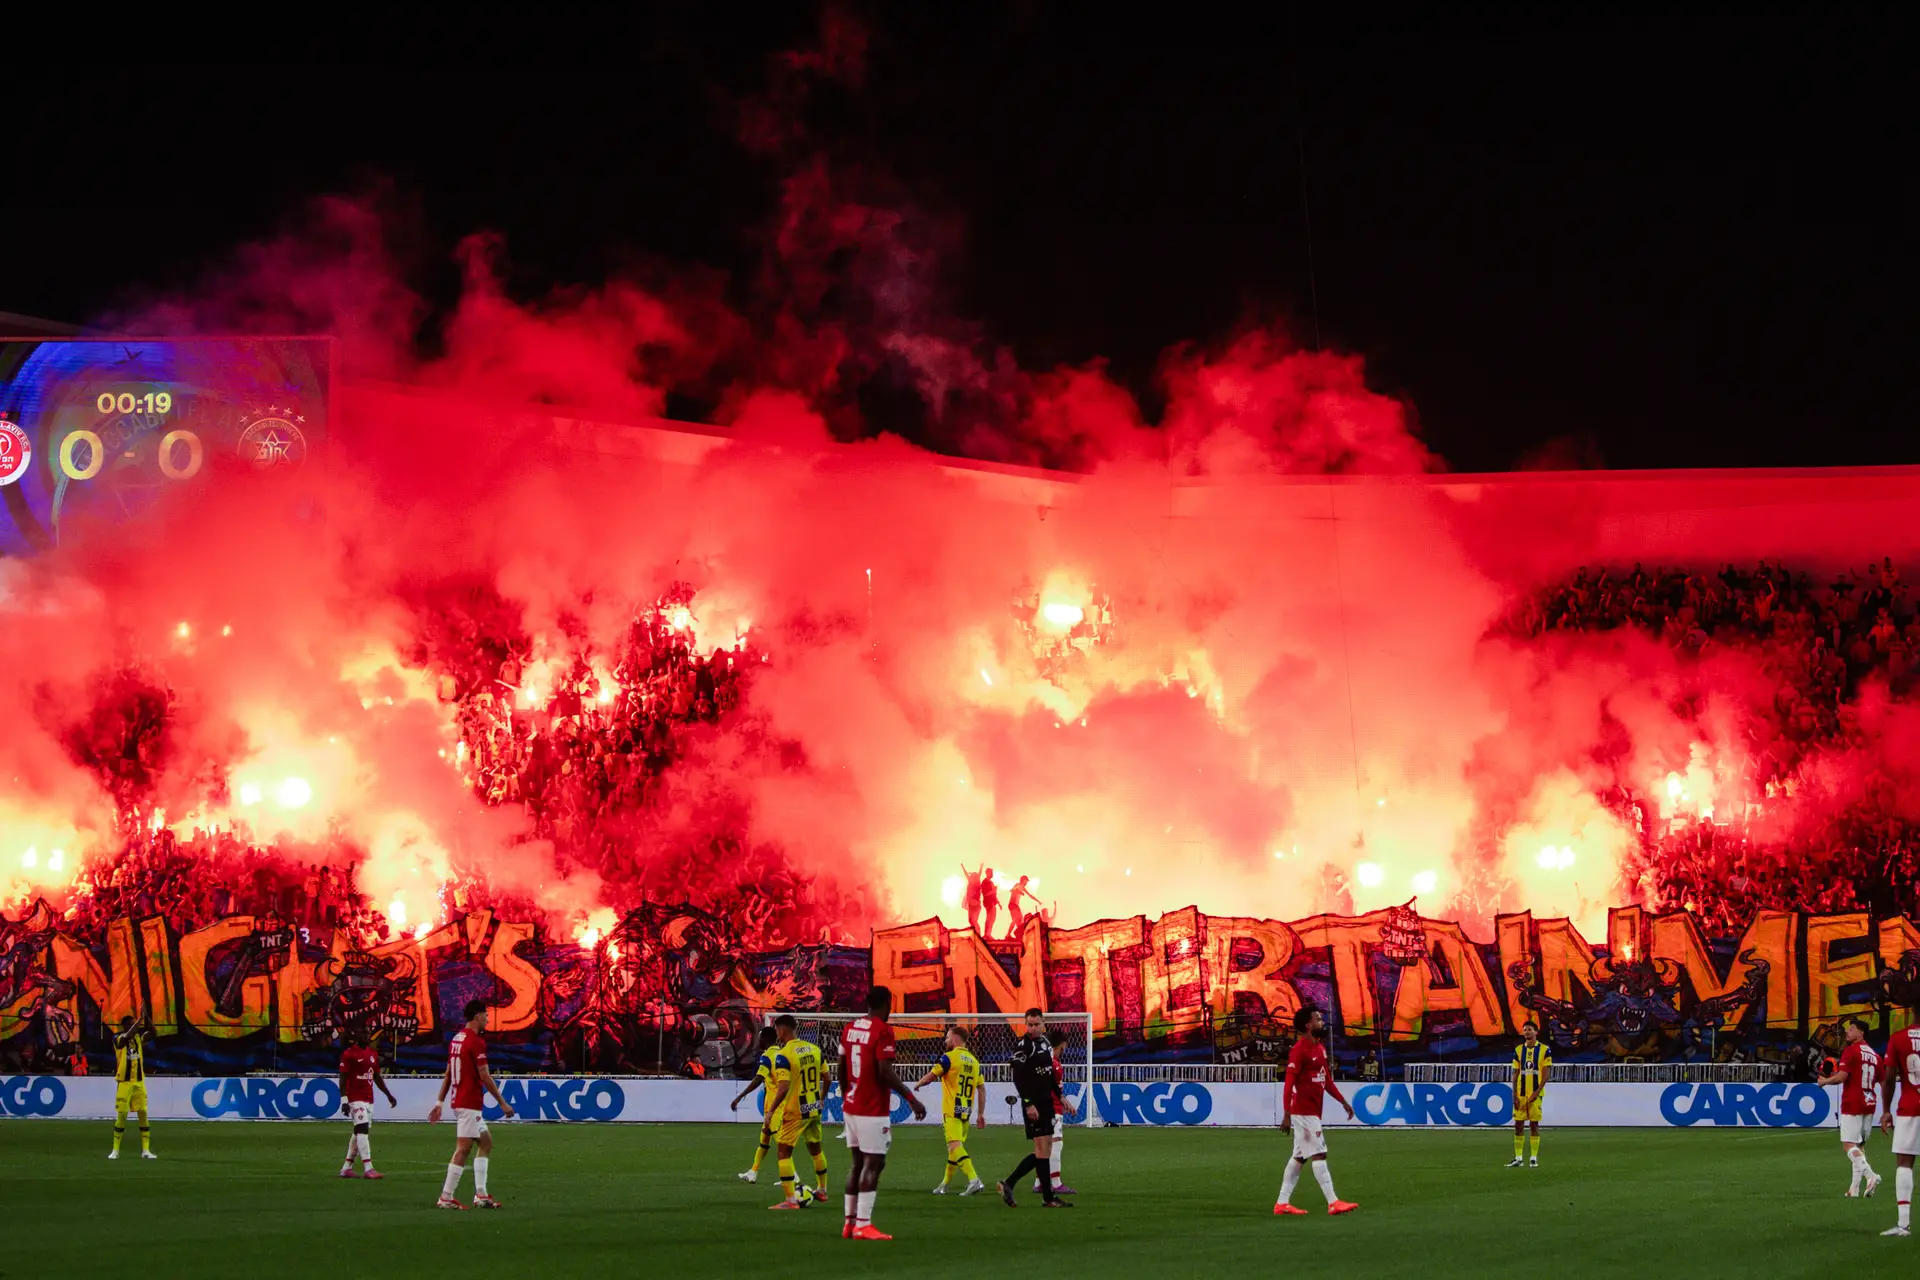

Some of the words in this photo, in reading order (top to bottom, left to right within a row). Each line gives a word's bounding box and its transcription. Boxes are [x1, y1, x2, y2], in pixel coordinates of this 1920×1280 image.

[97, 393, 172, 413] 00:19
[59, 430, 104, 480] 0
[158, 430, 203, 480] 0
[260, 934, 282, 948] TNT
[1391, 930, 1414, 946] TNT
[1222, 1046, 1249, 1064] TNT
[800, 1066, 817, 1094] 19
[956, 1075, 974, 1098] 36
[191, 1078, 341, 1119] CARGO
[1352, 1082, 1513, 1126] CARGO
[1660, 1083, 1831, 1127] CARGO
